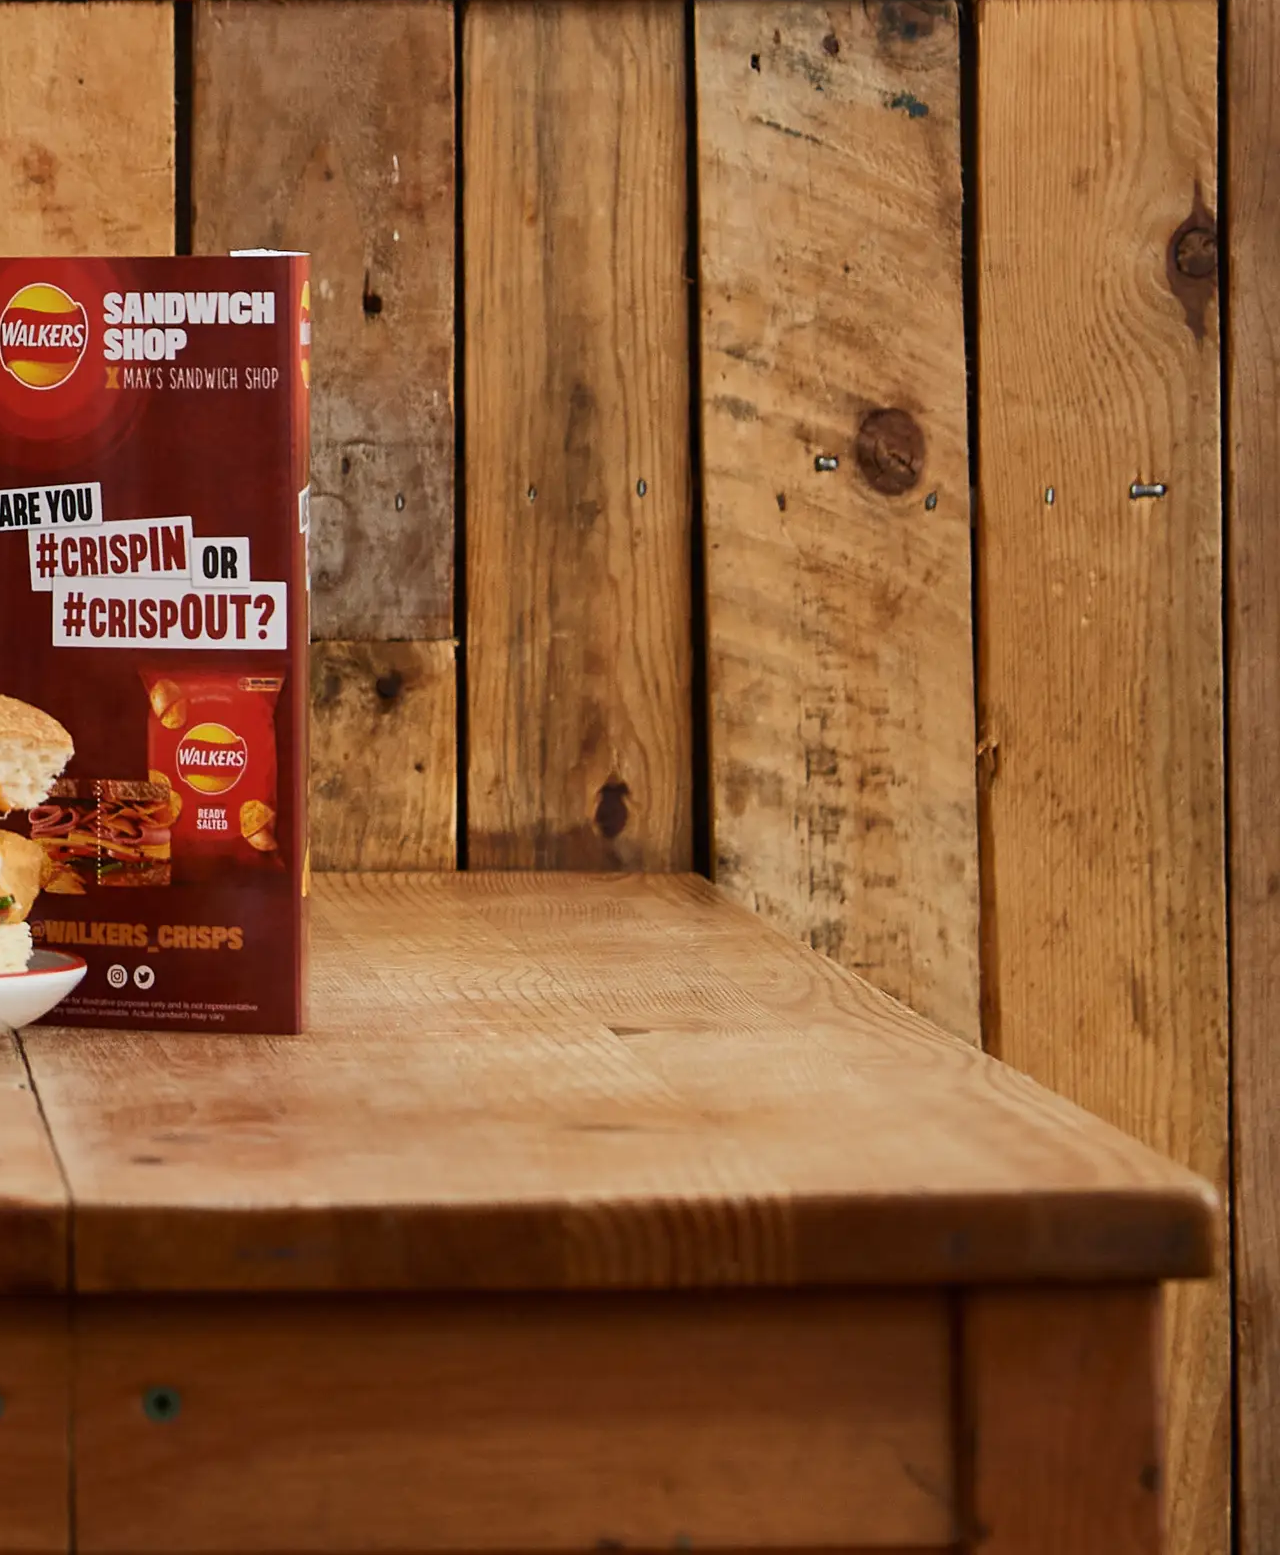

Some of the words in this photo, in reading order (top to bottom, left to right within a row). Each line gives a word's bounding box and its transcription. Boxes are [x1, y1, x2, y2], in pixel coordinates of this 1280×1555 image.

[103, 292, 275, 324] SANDWICH
[2, 319, 84, 347] WALKERS
[103, 328, 187, 360] SHOP
[123, 367, 163, 389] MAX'S
[169, 367, 238, 389] SANDWICH
[245, 367, 279, 389] SHOP
[0, 492, 40, 527] ARE
[45, 488, 92, 523] YOU
[36, 525, 187, 578] #CRISPIN
[202, 545, 237, 579] OR
[63, 592, 275, 640] #CRISPOUT?
[179, 747, 244, 766] WALKERS
[197, 820, 228, 830] SALTED
[198, 809, 225, 819] READY
[167, 1001, 180, 1009] and
[191, 1002, 203, 1010] not
